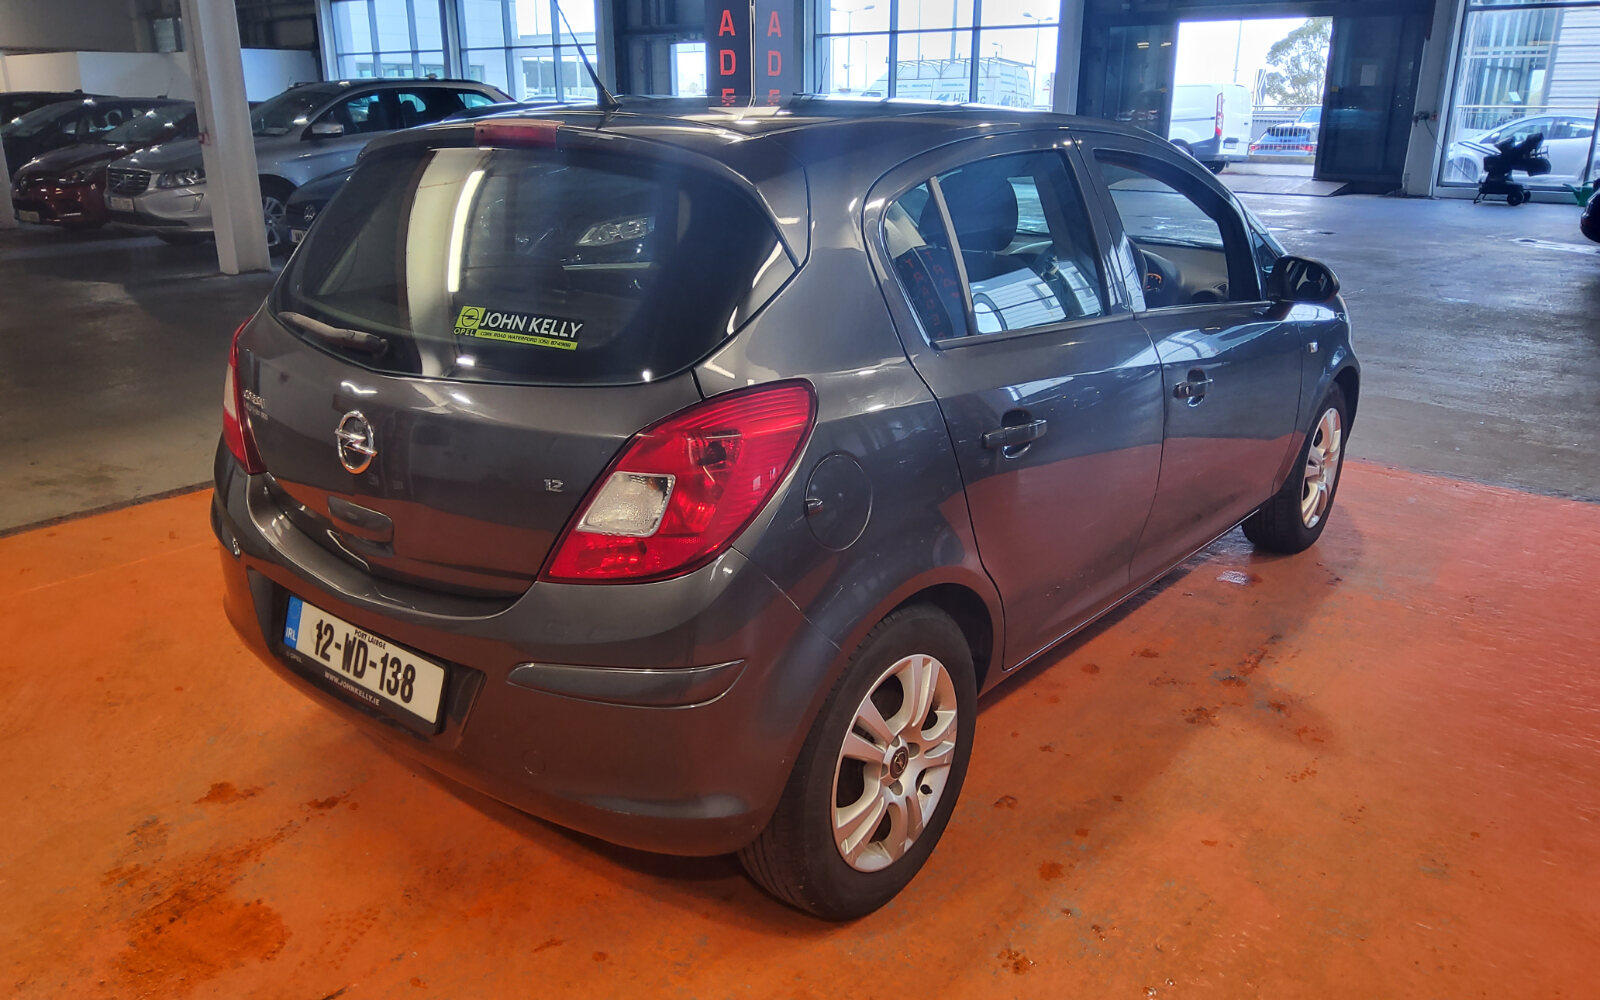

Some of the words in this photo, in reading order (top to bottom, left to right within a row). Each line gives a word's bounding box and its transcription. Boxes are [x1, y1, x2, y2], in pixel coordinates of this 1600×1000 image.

[453, 327, 475, 337] OPEL
[480, 312, 527, 332] JOHN
[528, 317, 583, 339] KELLY
[285, 626, 297, 642] IRL
[354, 629, 367, 640] PORT
[314, 618, 417, 704] 12-WD-138
[324, 671, 380, 706] WWW.JOHNKELLY.IE
